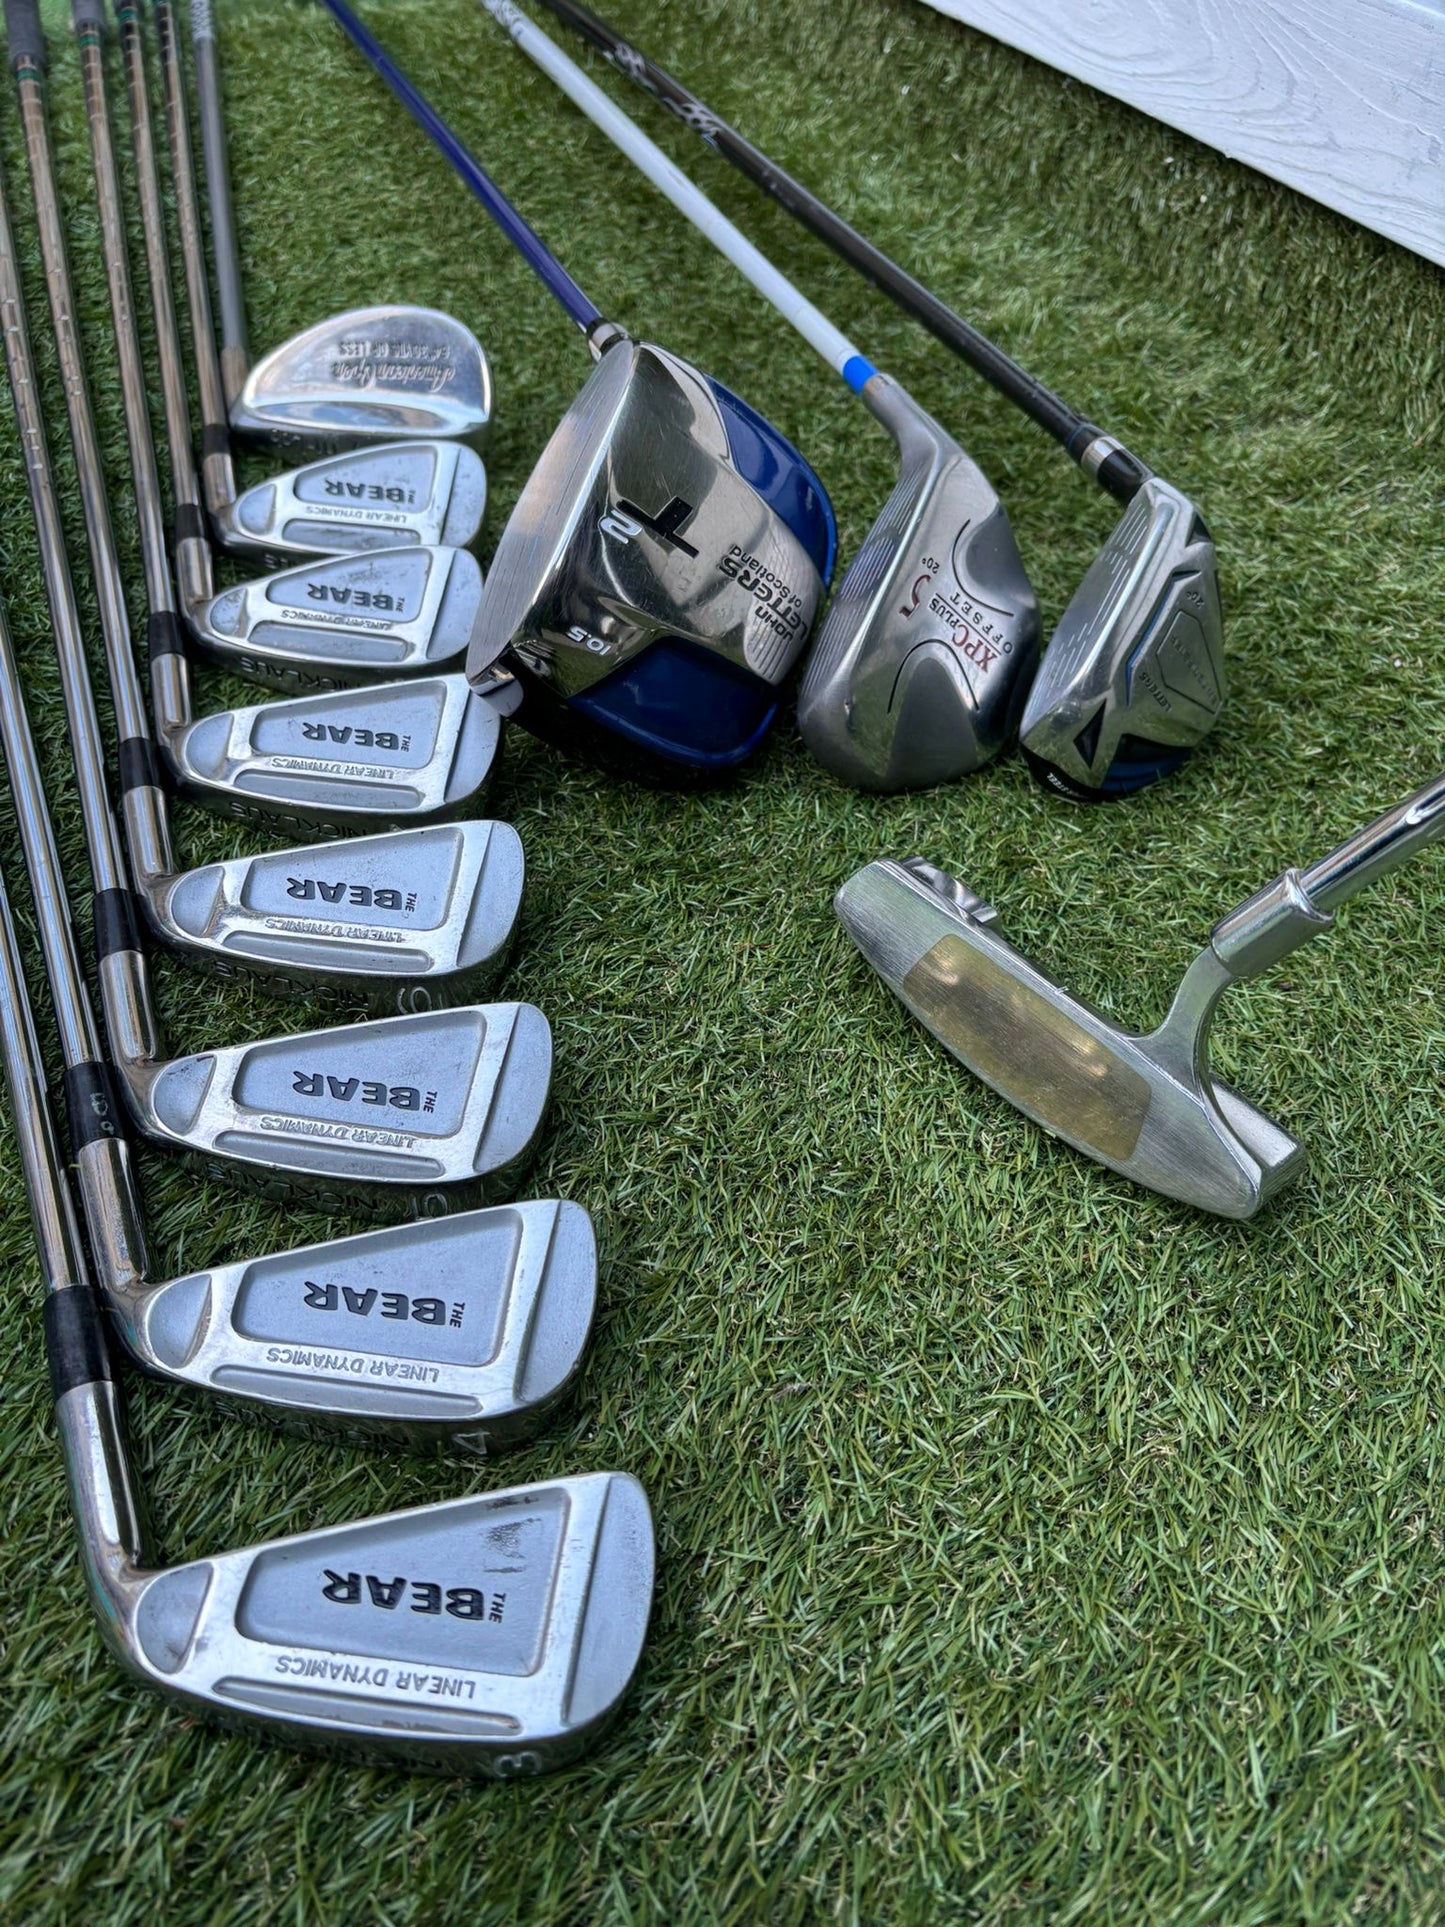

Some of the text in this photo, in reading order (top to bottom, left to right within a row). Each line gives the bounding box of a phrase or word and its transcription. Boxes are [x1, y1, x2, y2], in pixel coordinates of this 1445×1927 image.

[338, 341, 372, 358] LESS
[324, 480, 405, 504] BEAR
[305, 506, 407, 524] LINEAR DYNAMICS
[307, 583, 405, 612] THE BEAR
[719, 554, 808, 642] LETTERS
[898, 574, 932, 619] 5
[564, 625, 612, 656] 10.5
[754, 604, 795, 642] JOHN
[950, 592, 1013, 654] OFFSET
[302, 722, 411, 752] THE BEAR
[272, 757, 395, 780] LINEAR DYNAMICS
[228, 802, 366, 838] NICKLAUS
[286, 878, 416, 913] THE BEAR
[265, 918, 402, 943] LINEAR DYNAMICS
[212, 960, 369, 1007] NICKLAUS
[292, 1070, 438, 1114] THE BEAR
[260, 1116, 415, 1148] LINEAR DYNAMICS
[304, 1280, 465, 1330] THE BEAR
[266, 1346, 440, 1382] LINEAR DYNAMICS
[451, 1429, 490, 1456] 4
[322, 1568, 506, 1624] THE BEAR
[275, 1654, 475, 1700] LINEAR DYNAMICS
